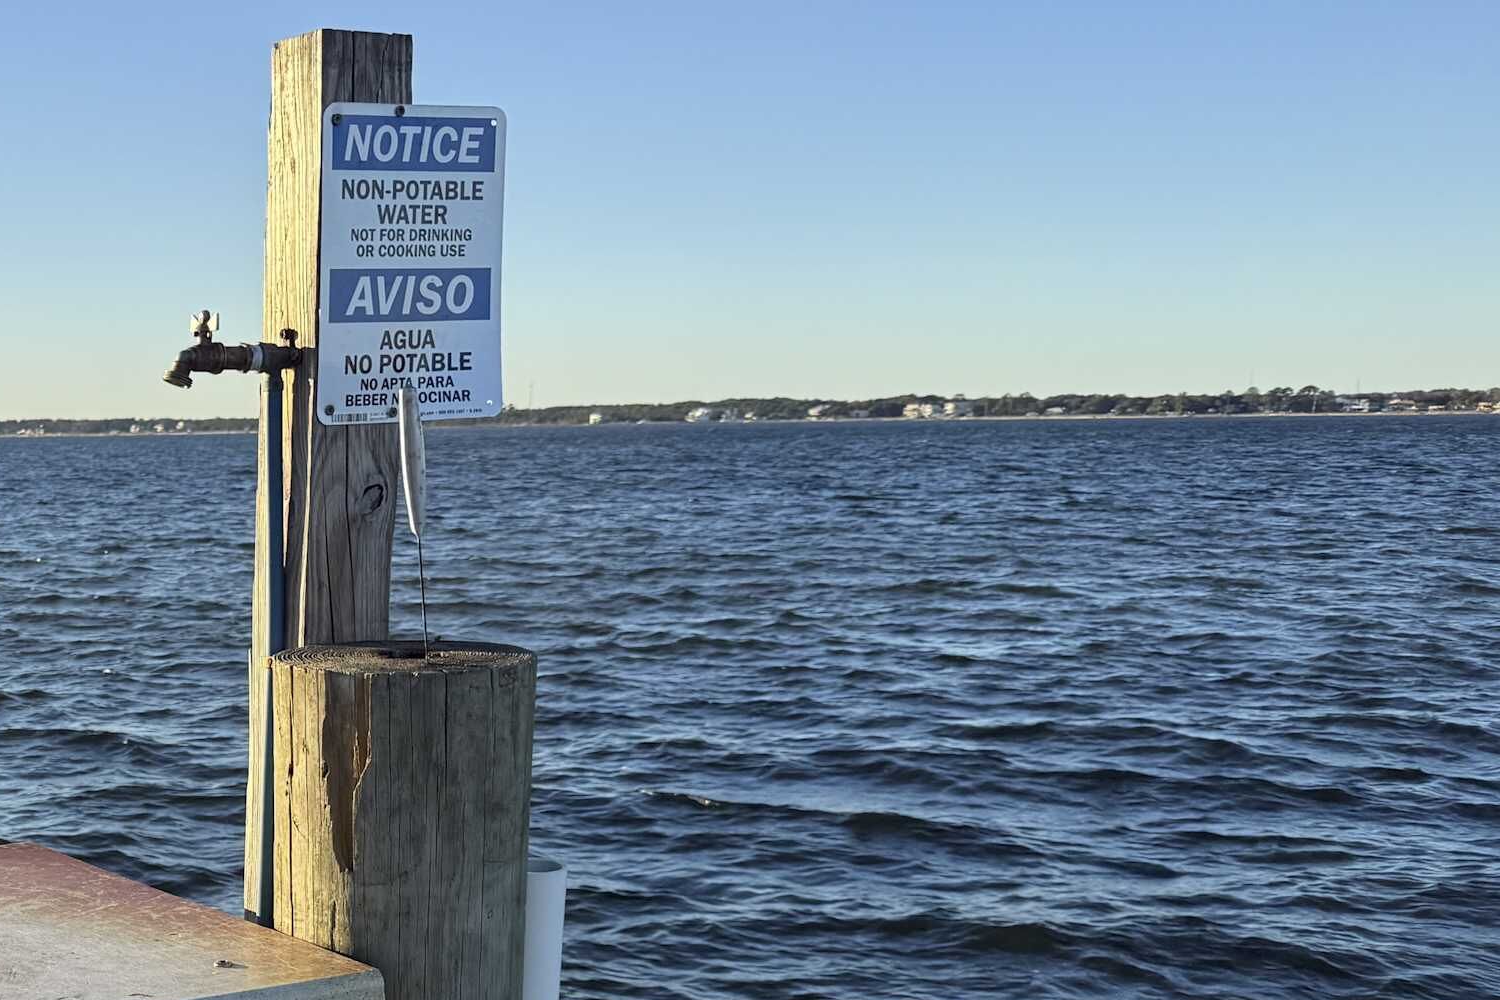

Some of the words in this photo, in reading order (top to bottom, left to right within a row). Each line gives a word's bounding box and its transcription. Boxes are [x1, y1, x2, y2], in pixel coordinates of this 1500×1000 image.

[344, 124, 485, 164] NOTICE
[341, 179, 485, 201] NON-POTABLE
[377, 204, 448, 225] WATER
[350, 228, 376, 242] NOT
[379, 228, 405, 242] FOR
[409, 229, 472, 242] DRINKING
[356, 245, 374, 258] OR
[378, 245, 436, 258] COOKING
[440, 244, 466, 258] USE
[345, 274, 475, 316] AVISO
[379, 329, 436, 350] AGUA
[344, 354, 373, 375] NO
[379, 351, 473, 374] POTABLE
[360, 378, 378, 391] NO
[381, 377, 413, 391] APTA
[417, 376, 455, 389] PARA
[345, 393, 388, 407] BEBER
[418, 390, 471, 404] OCINAR
